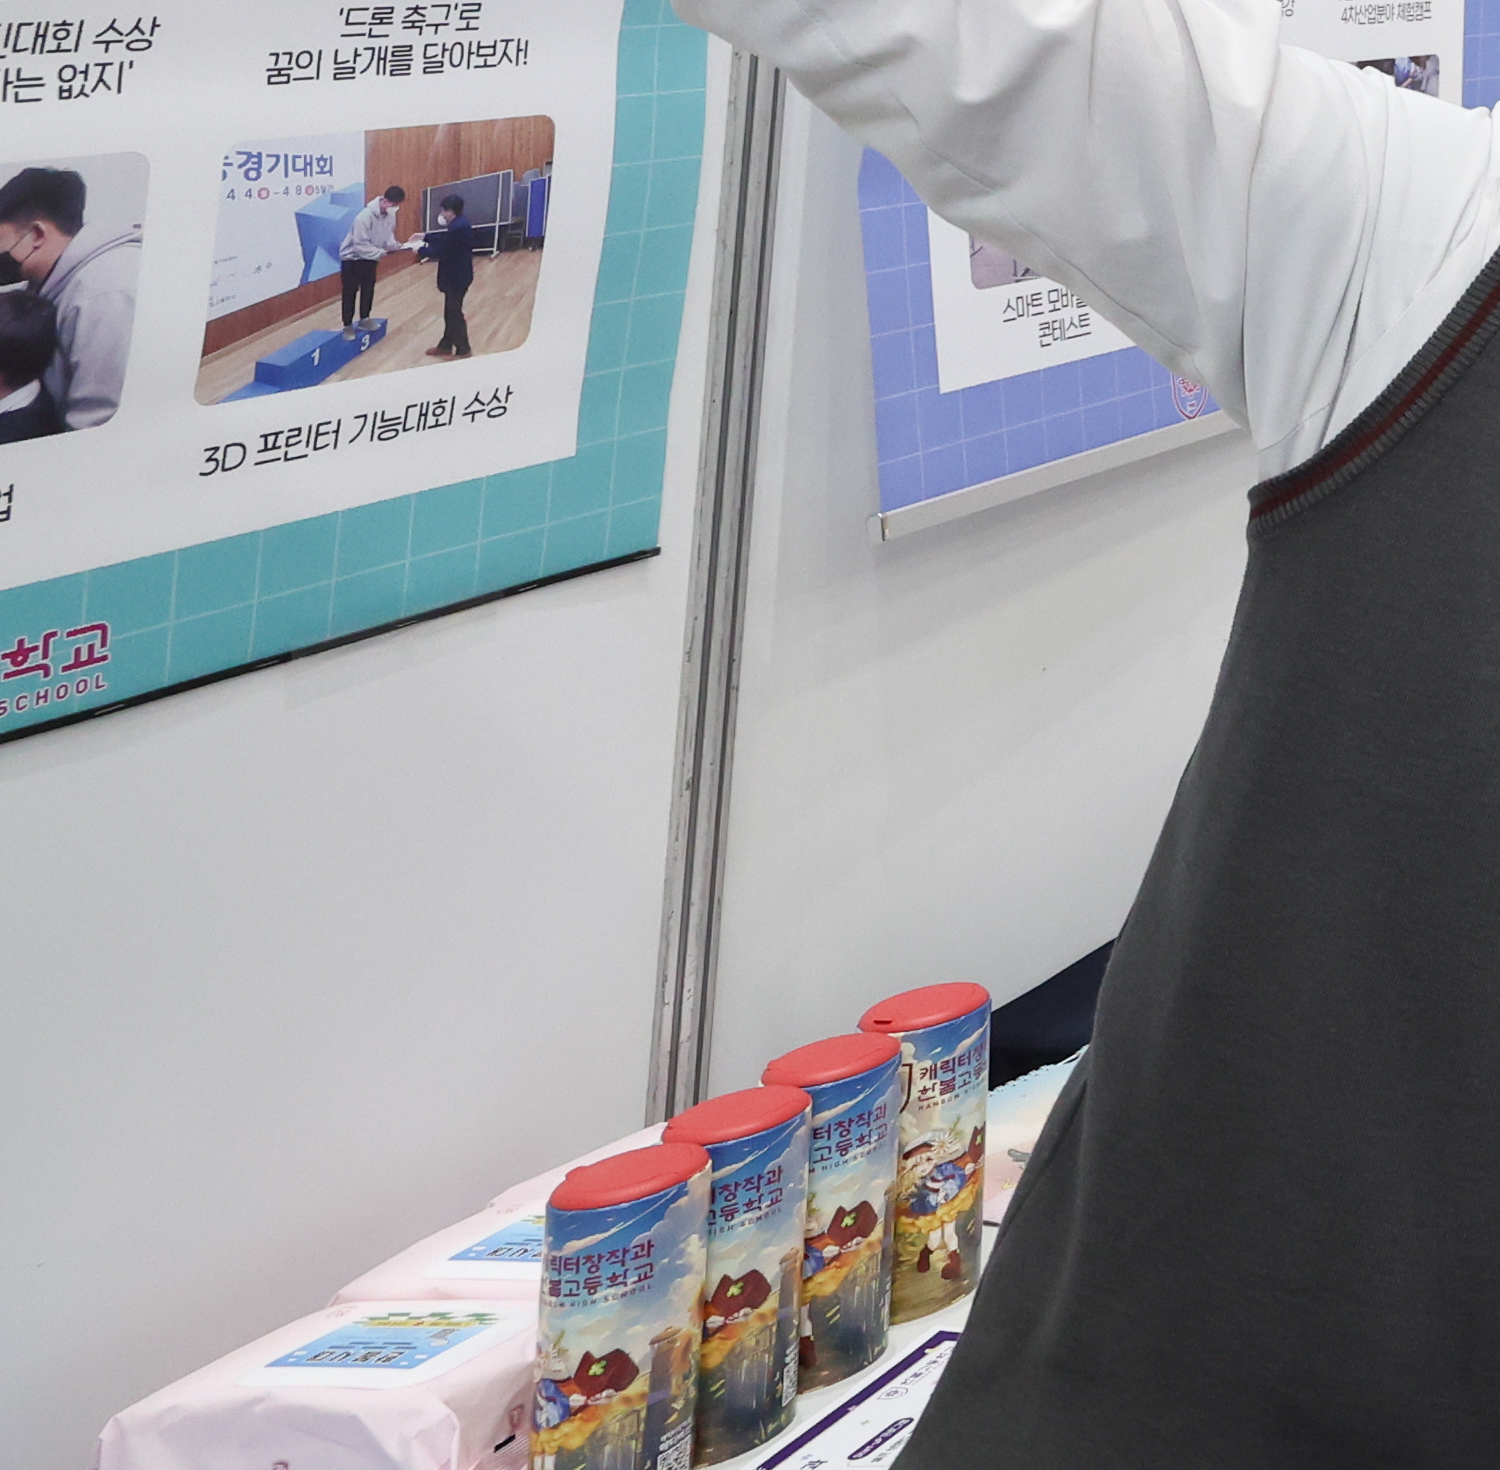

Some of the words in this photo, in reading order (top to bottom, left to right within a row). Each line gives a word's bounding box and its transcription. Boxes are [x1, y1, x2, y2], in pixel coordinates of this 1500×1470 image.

[91, 16, 161, 55] 수상
[339, 6, 394, 39] '드론
[401, 2, 482, 36] 축구'로
[57, 59, 134, 101] 없지'
[265, 49, 322, 85] 꿈의
[331, 44, 414, 81] 날개를
[423, 38, 529, 75] 달아보자!
[1002, 291, 1045, 323] 스마트
[1038, 312, 1093, 348] 콘테스트
[199, 442, 246, 477] 3D
[254, 418, 341, 467] 프린터
[348, 395, 455, 443] 기능대회
[462, 385, 514, 423] 수상
[1, 622, 110, 681] 학교
[543, 1239, 655, 1277] 릭터창작과
